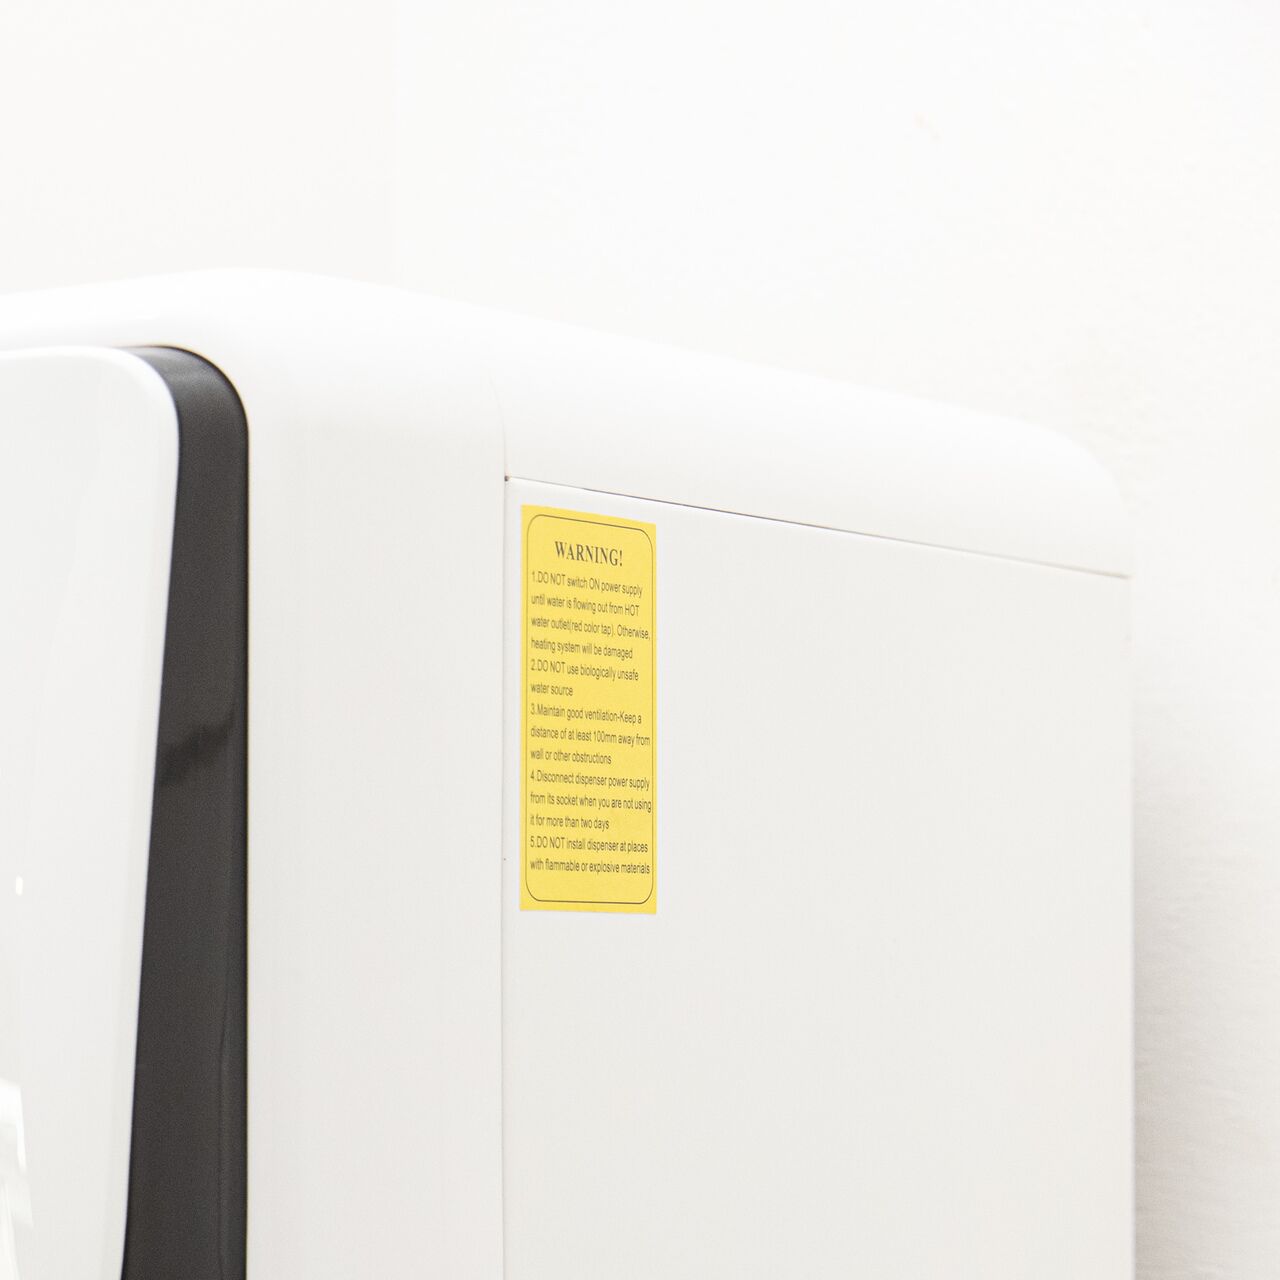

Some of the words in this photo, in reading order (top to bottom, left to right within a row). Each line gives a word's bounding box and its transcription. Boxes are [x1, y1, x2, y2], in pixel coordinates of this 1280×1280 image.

[555, 541, 622, 566] WARNING!
[550, 572, 565, 586] NOT
[567, 575, 587, 588] switch
[589, 577, 599, 590] ON
[601, 582, 621, 593] power
[622, 583, 641, 598] supply
[531, 593, 544, 605] until
[547, 595, 564, 608] water
[566, 596, 571, 608] is
[573, 597, 595, 614] flowing
[597, 601, 607, 612] out
[609, 601, 622, 614] from
[624, 603, 639, 616] HOT
[531, 615, 549, 628] water
[583, 621, 599, 633] color
[531, 636, 555, 653] heating
[557, 640, 579, 654] system
[582, 642, 591, 654] will
[594, 643, 601, 655] be
[604, 644, 632, 660] damaged
[550, 661, 565, 673] NOT
[567, 665, 578, 674] use
[580, 664, 615, 681] biologically
[617, 669, 638, 680] unsafe
[531, 681, 549, 694] water
[551, 685, 572, 696] source
[567, 707, 583, 720] good
[638, 715, 641, 723] a
[530, 725, 558, 738] distance
[560, 727, 567, 739] of
[568, 728, 574, 739] at
[576, 728, 591, 741] least
[593, 730, 616, 742] 100mm
[618, 735, 634, 747] away
[636, 733, 649, 745] from
[530, 747, 543, 759] wall
[546, 751, 551, 760] or
[553, 749, 570, 761] other
[572, 750, 611, 764] obstructions
[576, 772, 606, 787] dispenser
[608, 777, 627, 788] power
[629, 776, 649, 790] supply
[530, 792, 545, 803] from
[556, 794, 577, 805] socket
[579, 795, 595, 806] when
[598, 799, 609, 809] you
[611, 800, 621, 808] are
[623, 798, 633, 809] not
[635, 798, 651, 812] using
[530, 814, 534, 825] it
[536, 814, 544, 825] for
[546, 818, 563, 826] more
[565, 816, 578, 827] than
[581, 817, 591, 828] two
[594, 818, 609, 831] days
[550, 836, 564, 848] NOT
[566, 837, 585, 849] install
[587, 838, 618, 852] dispenser
[620, 840, 625, 851] at
[627, 840, 647, 853] places
[530, 858, 543, 869] with
[545, 858, 579, 871] flammable
[581, 863, 587, 871] or
[589, 861, 619, 874] explosive
[621, 862, 649, 874] materials
